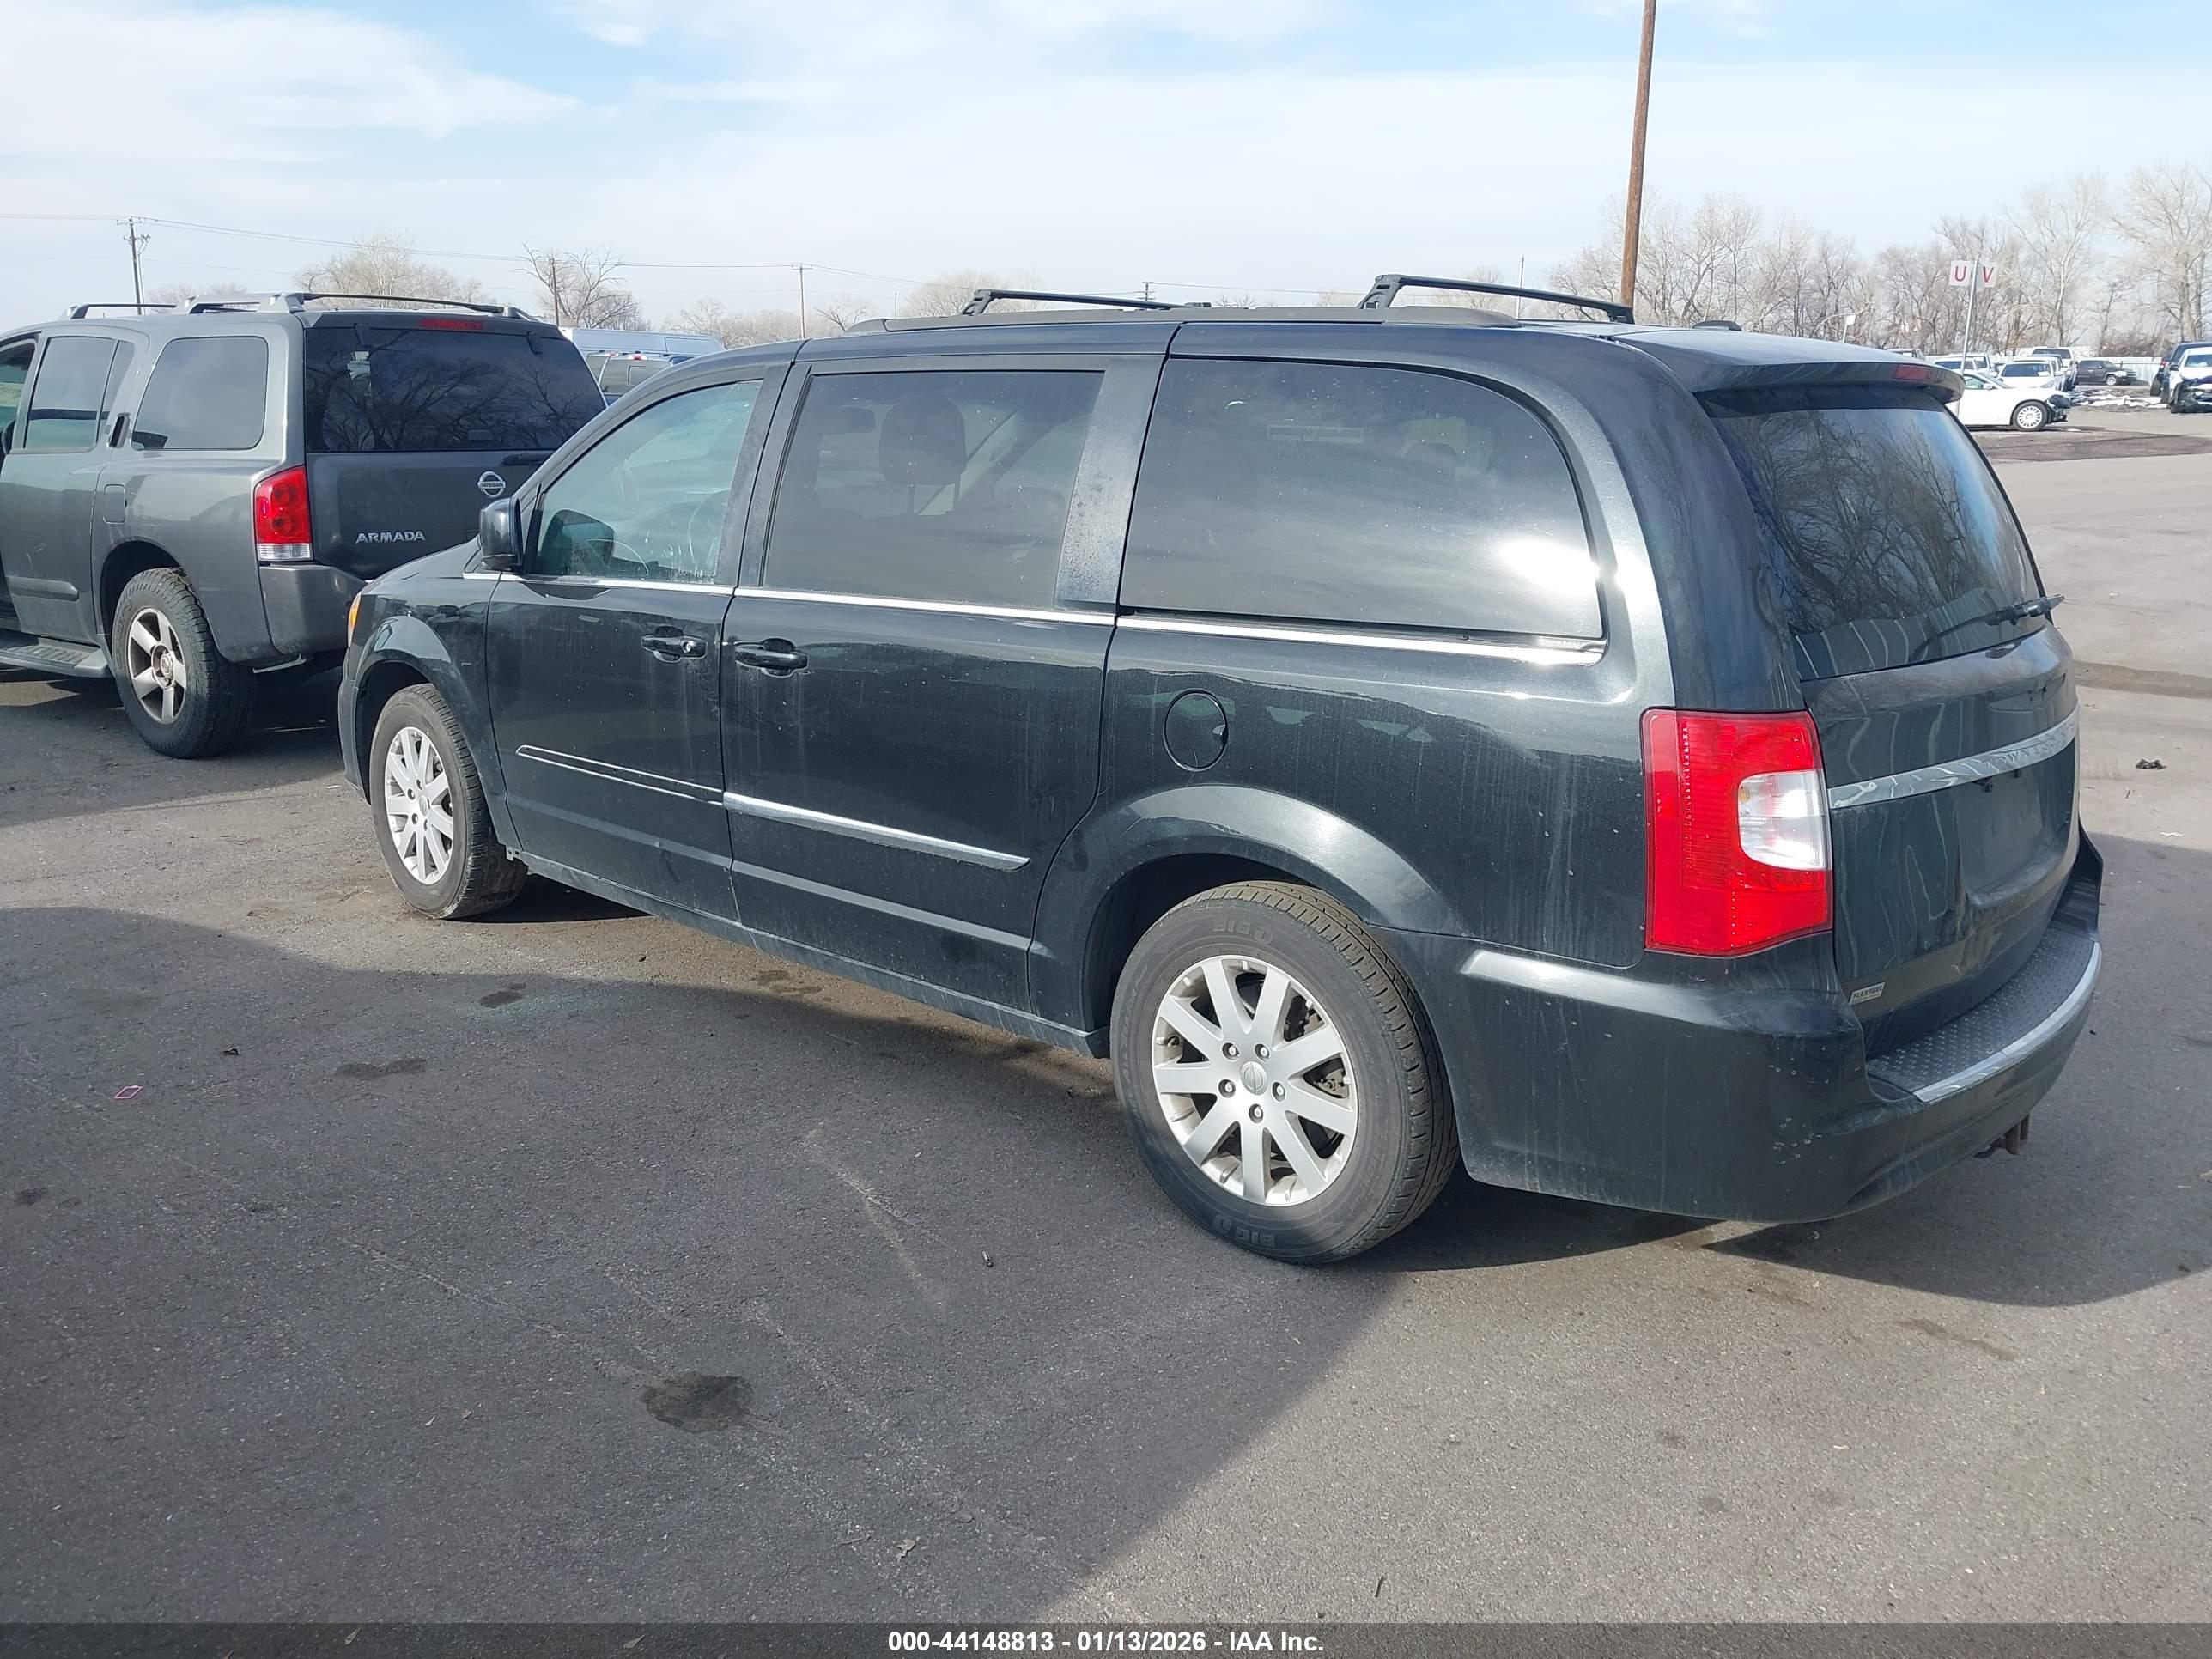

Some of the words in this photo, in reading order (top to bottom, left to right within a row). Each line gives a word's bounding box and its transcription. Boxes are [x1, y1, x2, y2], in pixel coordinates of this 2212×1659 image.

[1954, 265, 1967, 282] U
[1983, 266, 1995, 283] V
[481, 481, 504, 489] NISSAN
[356, 530, 426, 544] ARMADA
[1212, 919, 1250, 936] BIG
[1235, 1225, 1275, 1249] BIG
